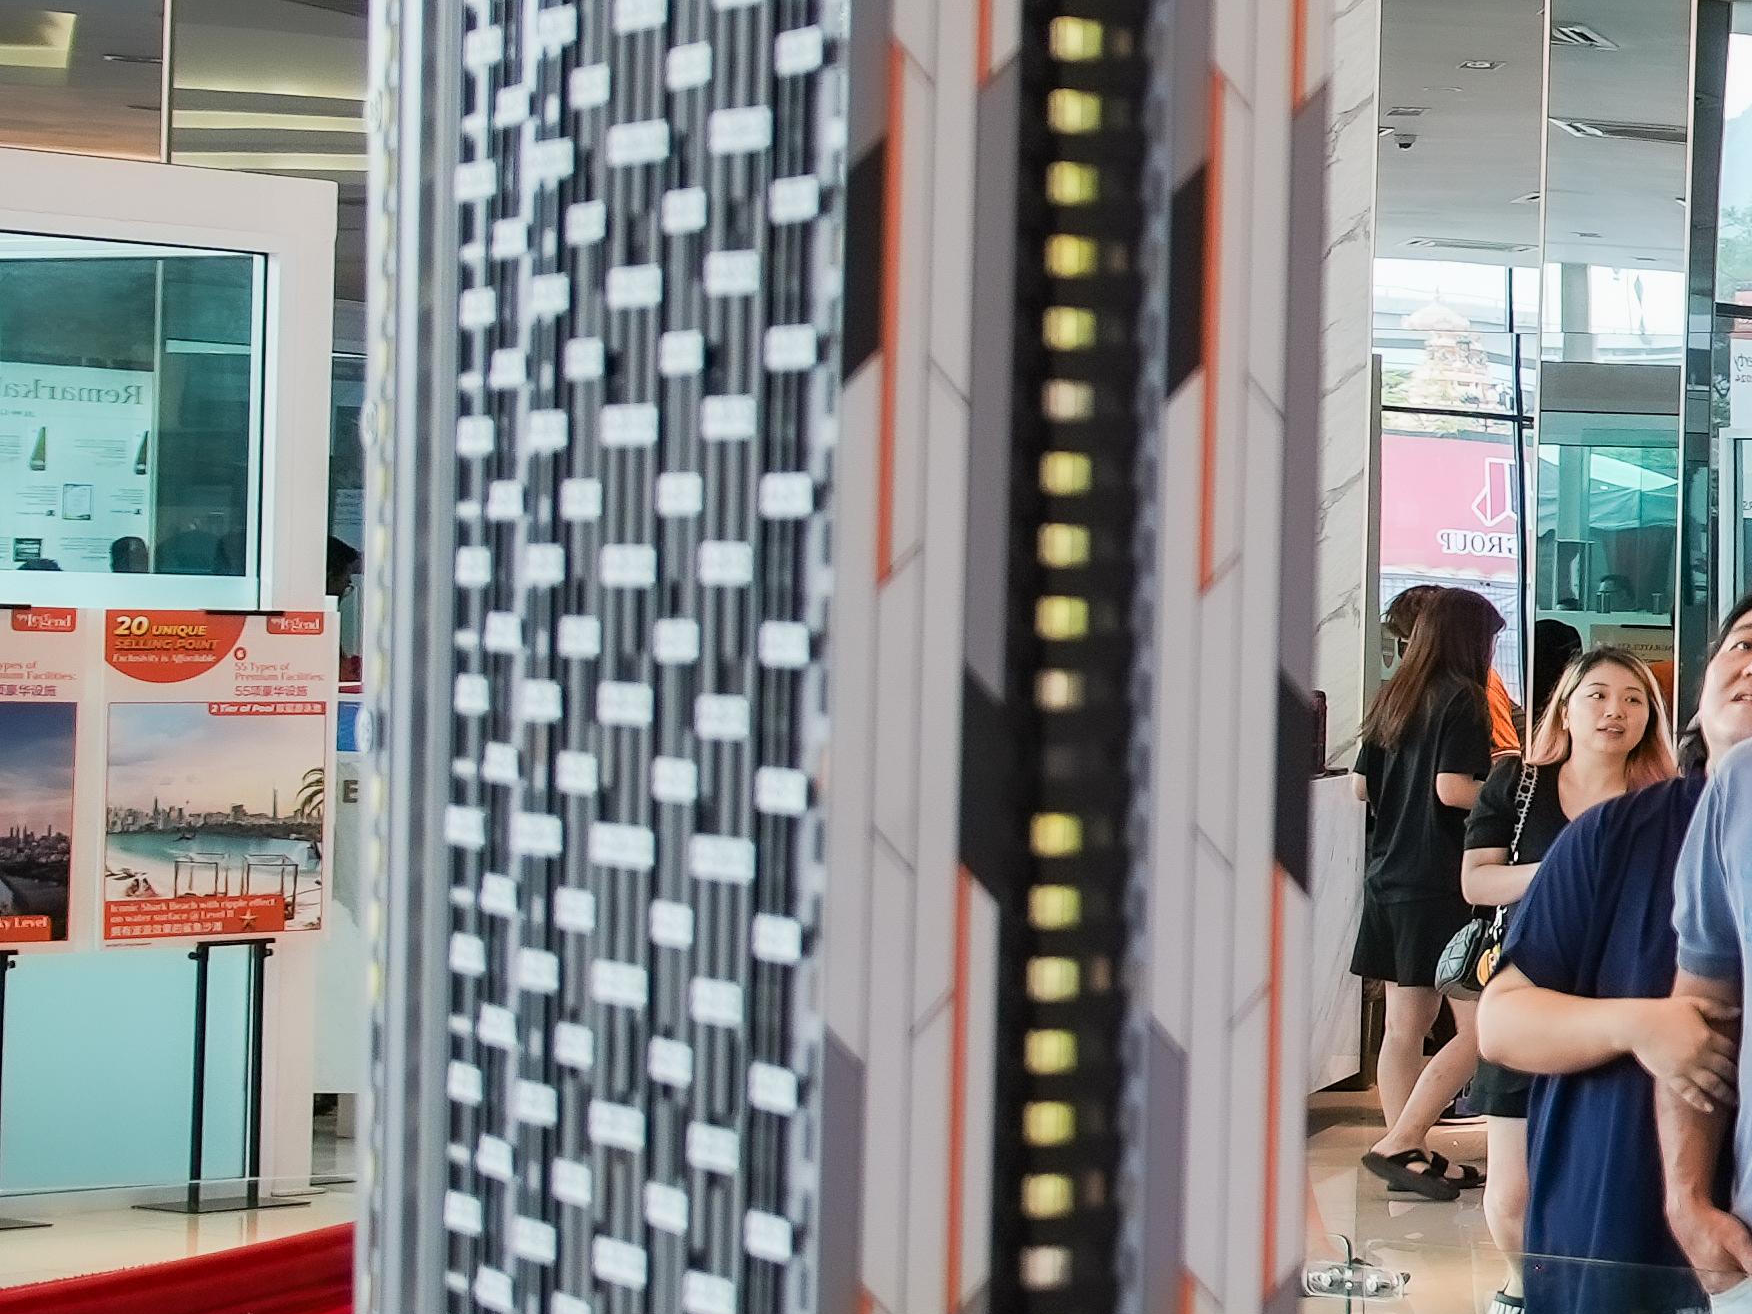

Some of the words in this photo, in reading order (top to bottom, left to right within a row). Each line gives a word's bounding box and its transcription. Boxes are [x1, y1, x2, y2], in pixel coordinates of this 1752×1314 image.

[113, 615, 150, 636] 20
[151, 624, 208, 637] UNIQUE
[114, 638, 173, 650] SELLING
[176, 638, 219, 651] POINT
